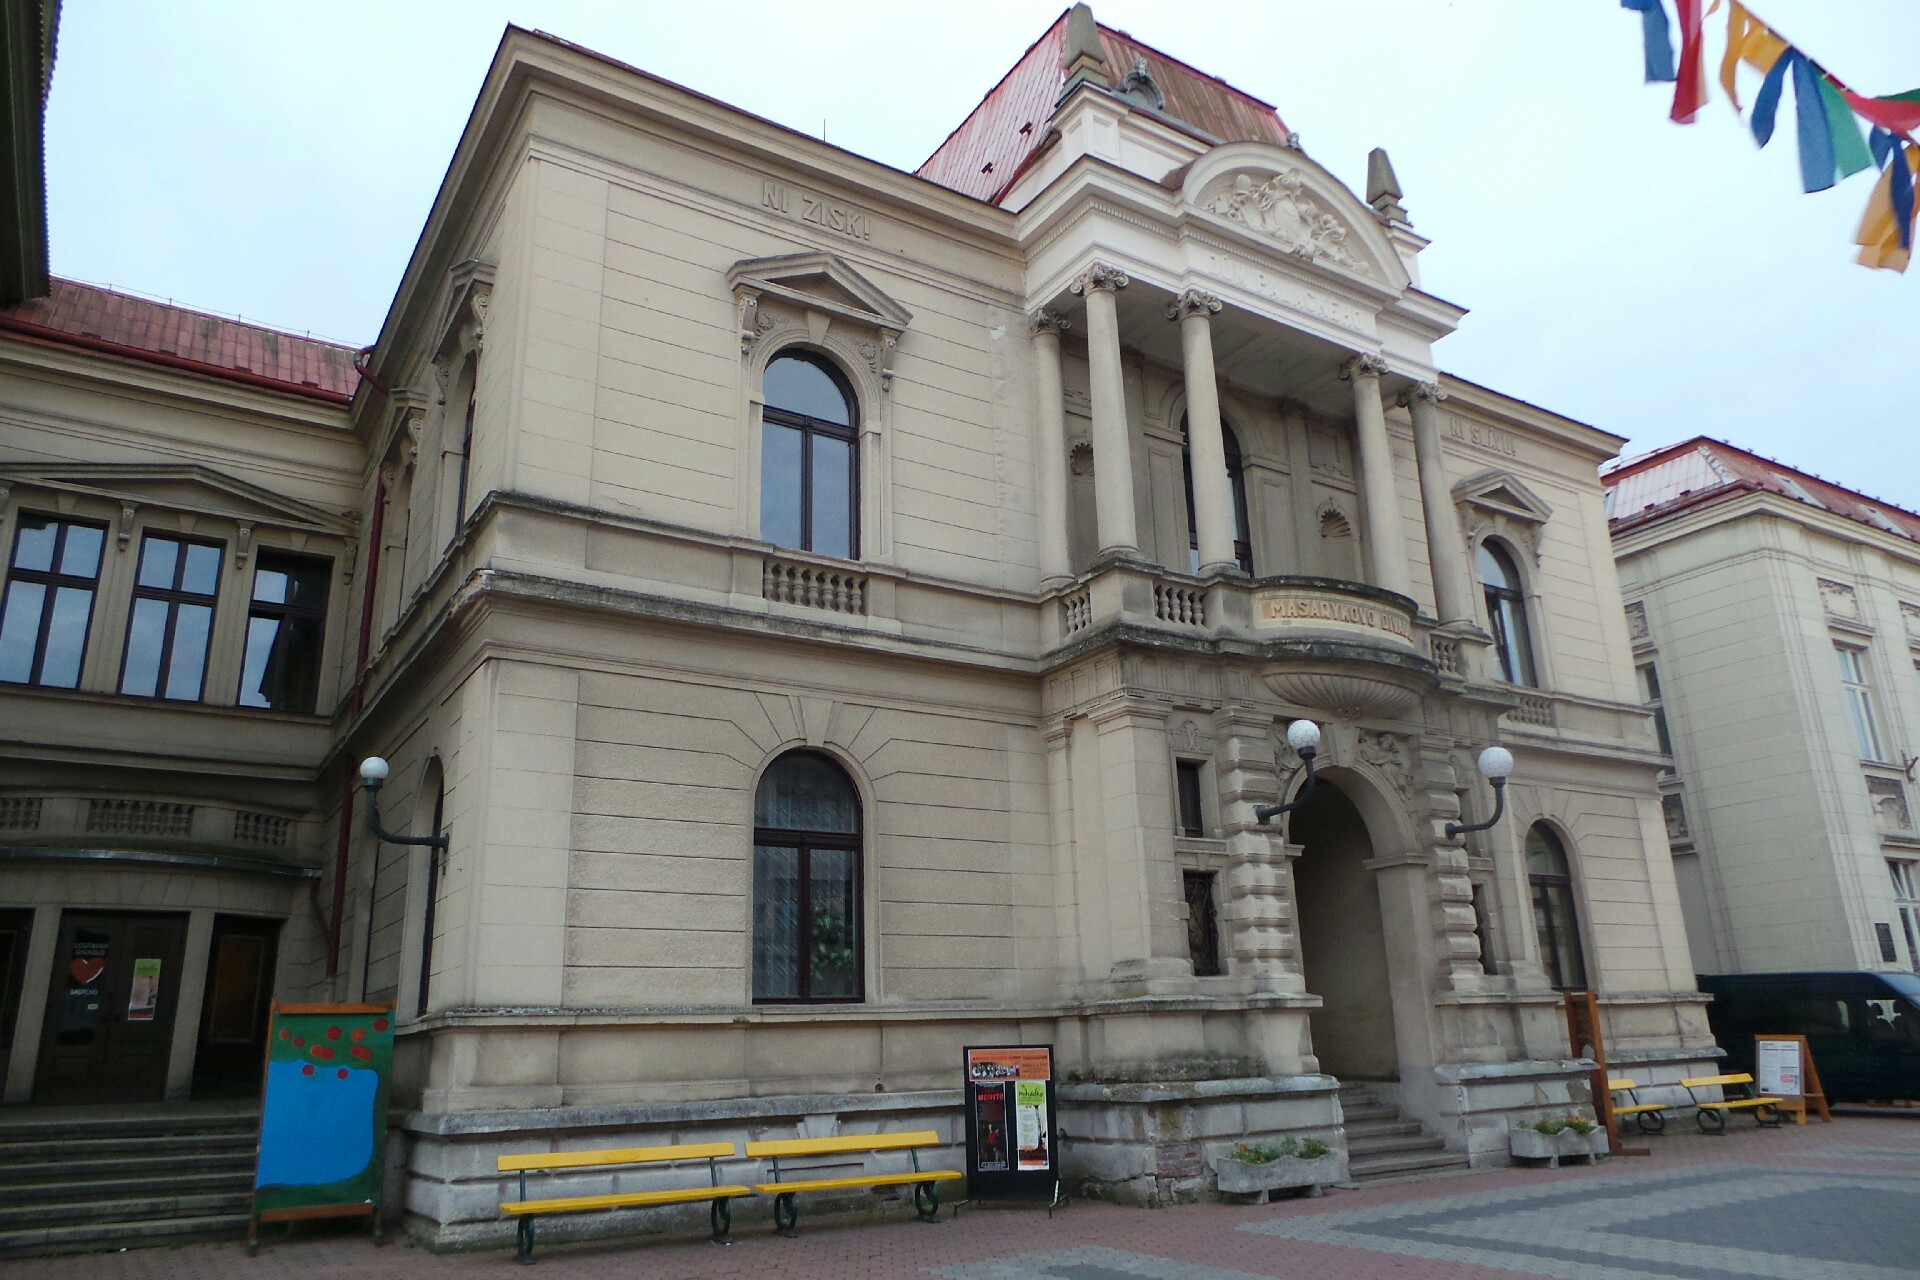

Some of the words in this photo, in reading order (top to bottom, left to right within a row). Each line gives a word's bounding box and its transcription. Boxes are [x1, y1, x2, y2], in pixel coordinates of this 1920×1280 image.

[763, 180, 788, 213] NI
[803, 195, 870, 241] ZISK!
[1450, 415, 1466, 440] NI
[1270, 599, 1376, 627] MASARYKOVO
